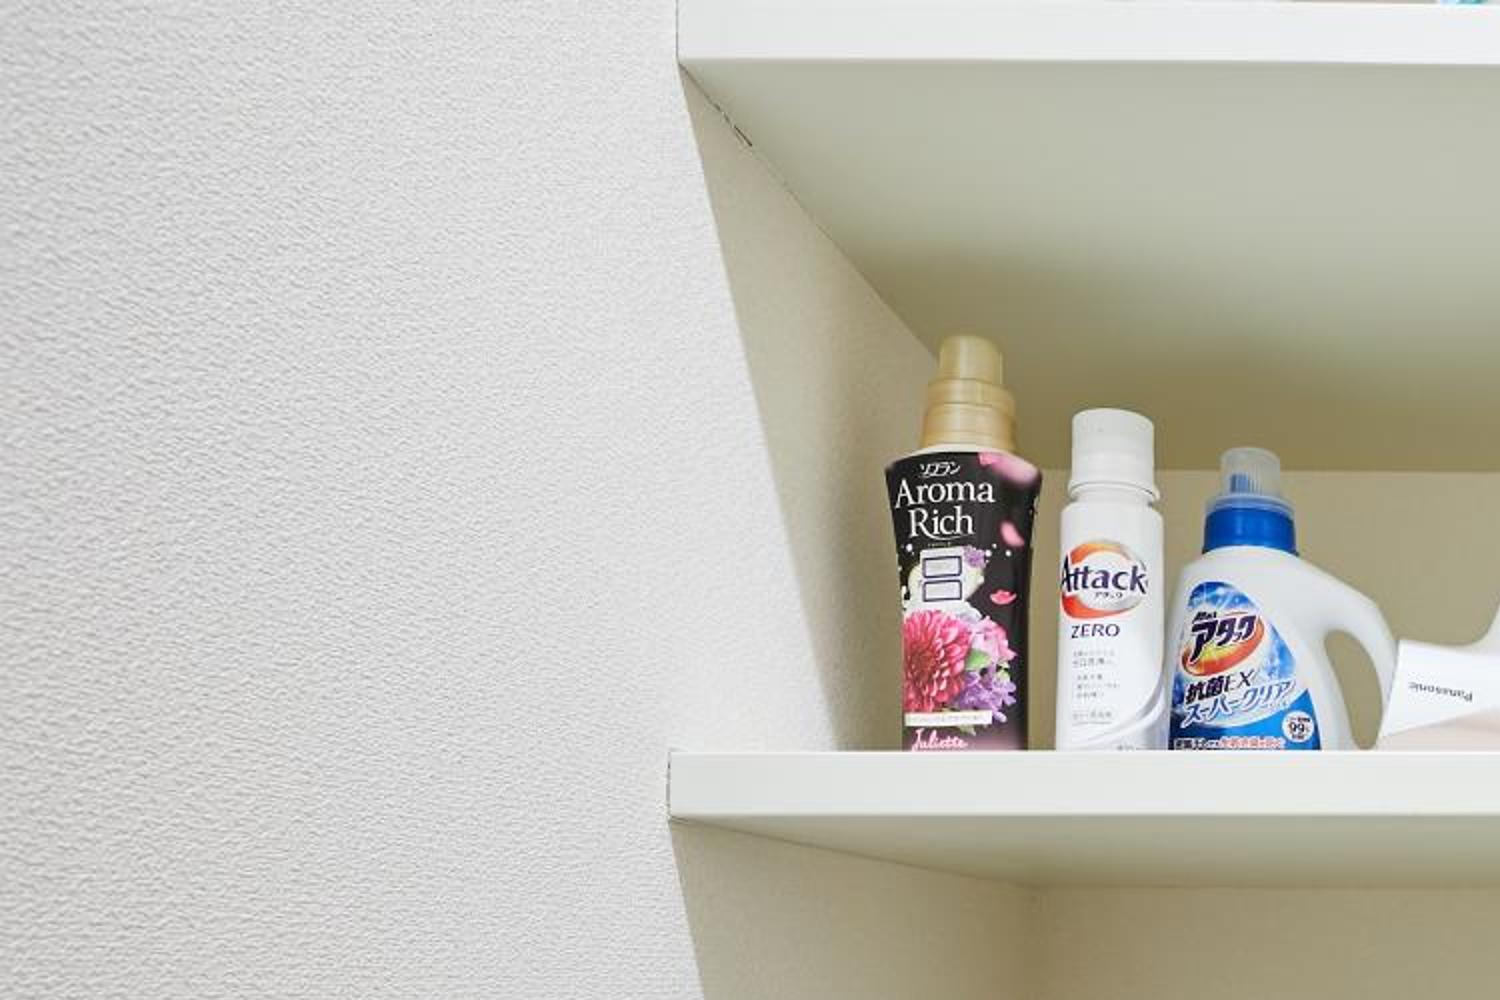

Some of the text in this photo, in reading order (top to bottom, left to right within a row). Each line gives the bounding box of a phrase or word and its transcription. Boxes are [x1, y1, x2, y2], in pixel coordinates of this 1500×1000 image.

[895, 478, 996, 510] Aroma
[908, 505, 975, 541] Rich
[1060, 553, 1148, 595] Attack
[1071, 623, 1121, 639] ZERO
[1189, 615, 1257, 663] アタック
[1180, 680, 1296, 729] スーパークリア
[1185, 668, 1254, 705] 抗菌EX
[1408, 680, 1474, 702] Panasonic
